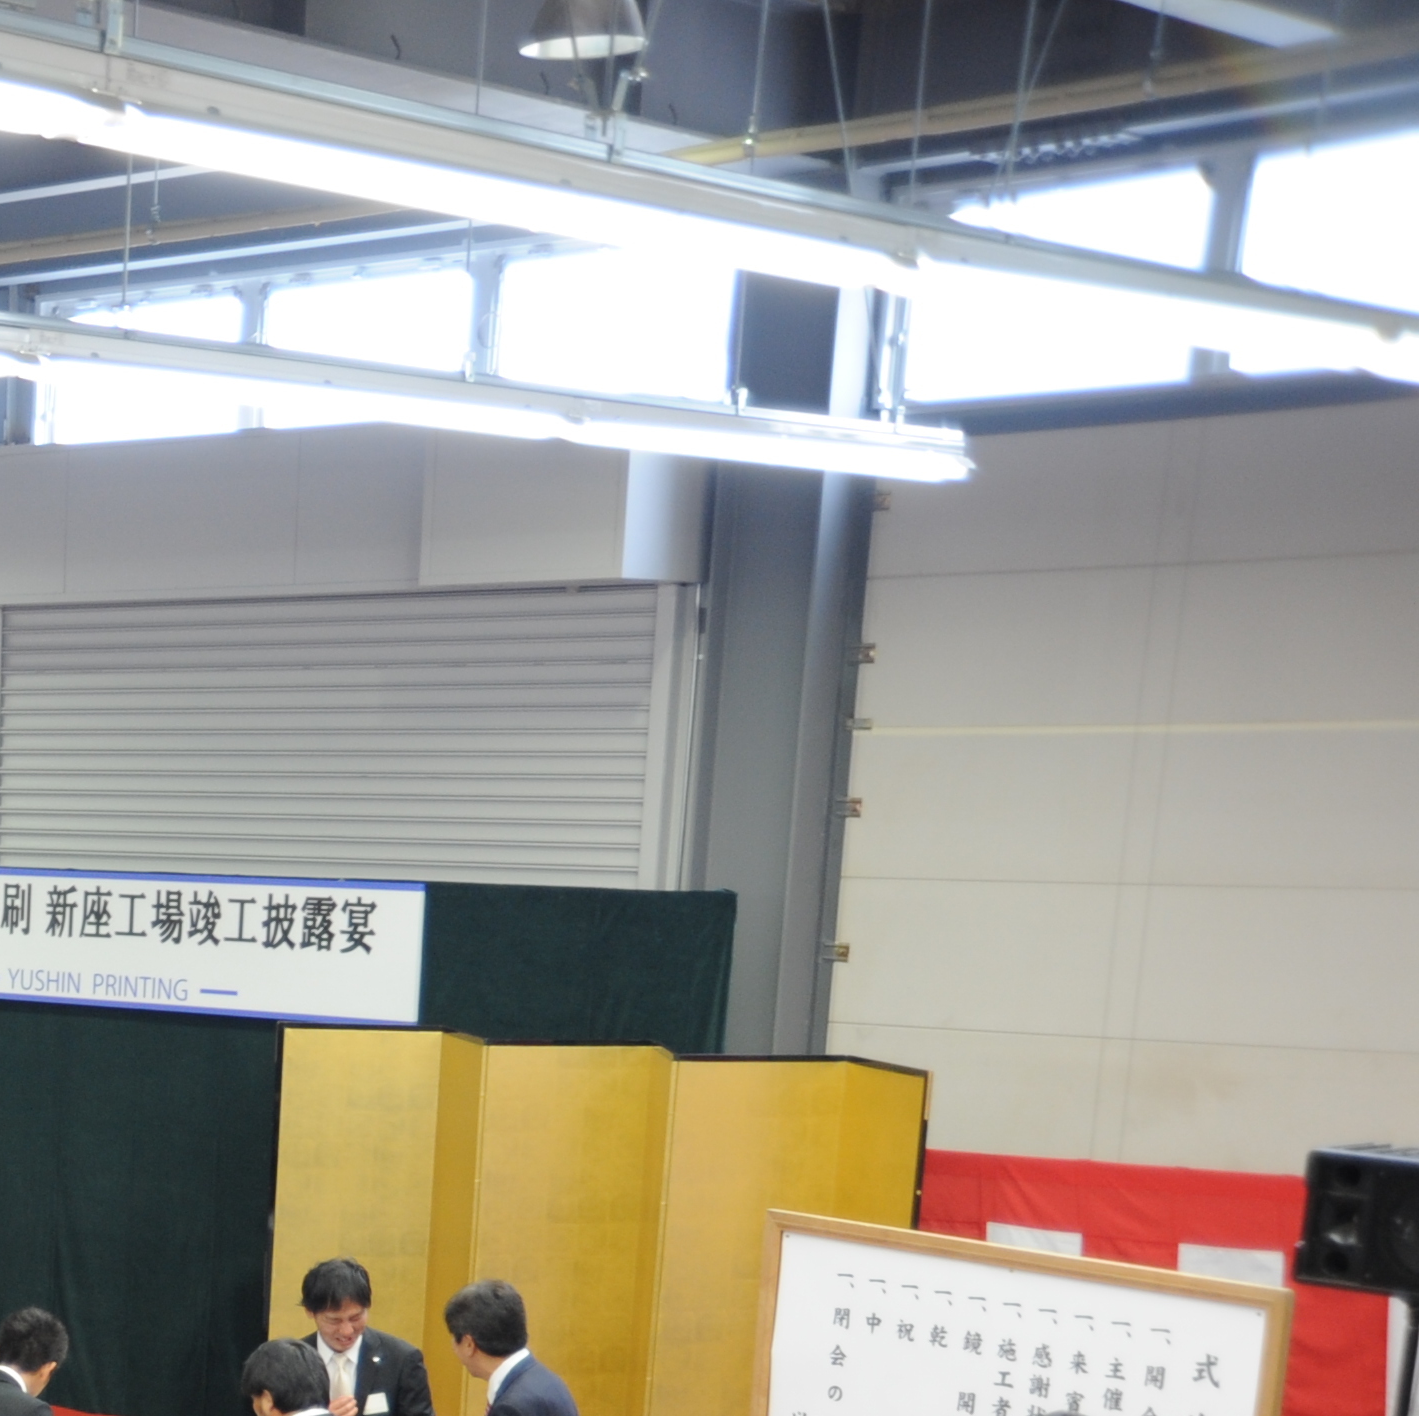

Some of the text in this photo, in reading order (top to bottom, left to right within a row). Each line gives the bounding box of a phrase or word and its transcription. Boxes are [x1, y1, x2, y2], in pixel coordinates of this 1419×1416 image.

[45, 885, 377, 954] 新座工場竣工披露宴
[8, 968, 189, 1001] YUSHIN PRINTING
